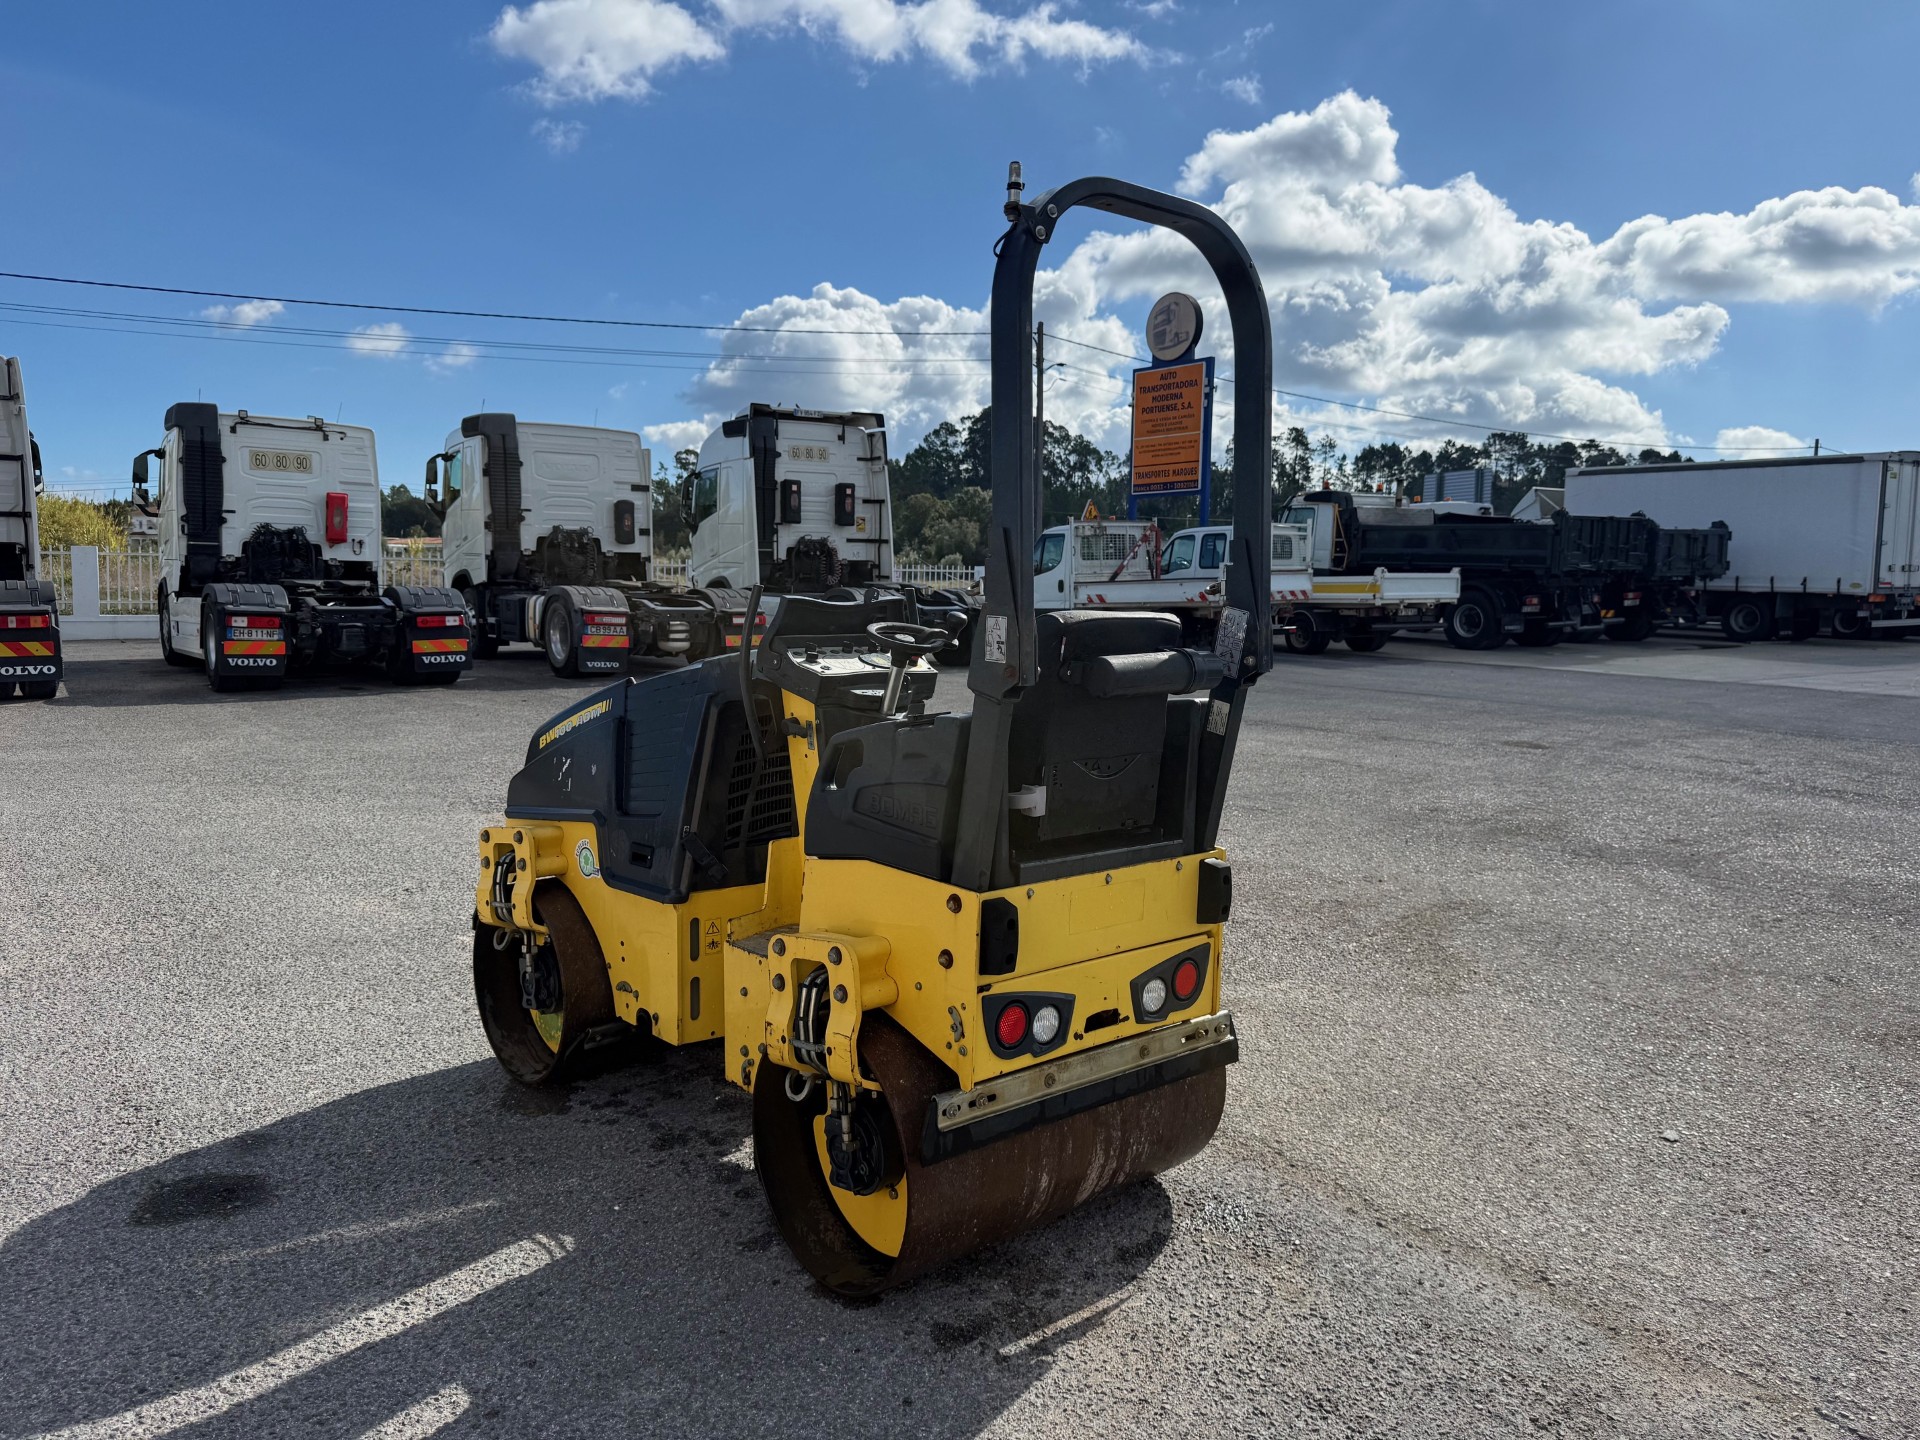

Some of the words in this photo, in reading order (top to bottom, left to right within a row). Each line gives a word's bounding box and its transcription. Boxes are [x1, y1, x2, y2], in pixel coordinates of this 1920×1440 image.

[1160, 371, 1177, 381] AUTO
[1139, 379, 1199, 394] TRANSPORTADORA
[1151, 392, 1184, 403] MODERNA
[1141, 403, 1180, 415] PORTUENSE,
[1180, 401, 1194, 410] S.A.
[792, 448, 800, 458] 60
[805, 448, 813, 459] 80
[818, 449, 827, 460] 90
[255, 453, 266, 467] 60
[276, 455, 287, 469] 80
[296, 456, 308, 470] 90
[1135, 468, 1170, 480] TRANSPORTES
[1172, 466, 1198, 478] MARQUES
[226, 657, 277, 666] VOLVO
[421, 654, 466, 664] VOLVO
[0, 665, 56, 676] OLVO
[870, 791, 938, 830] BOMAG
